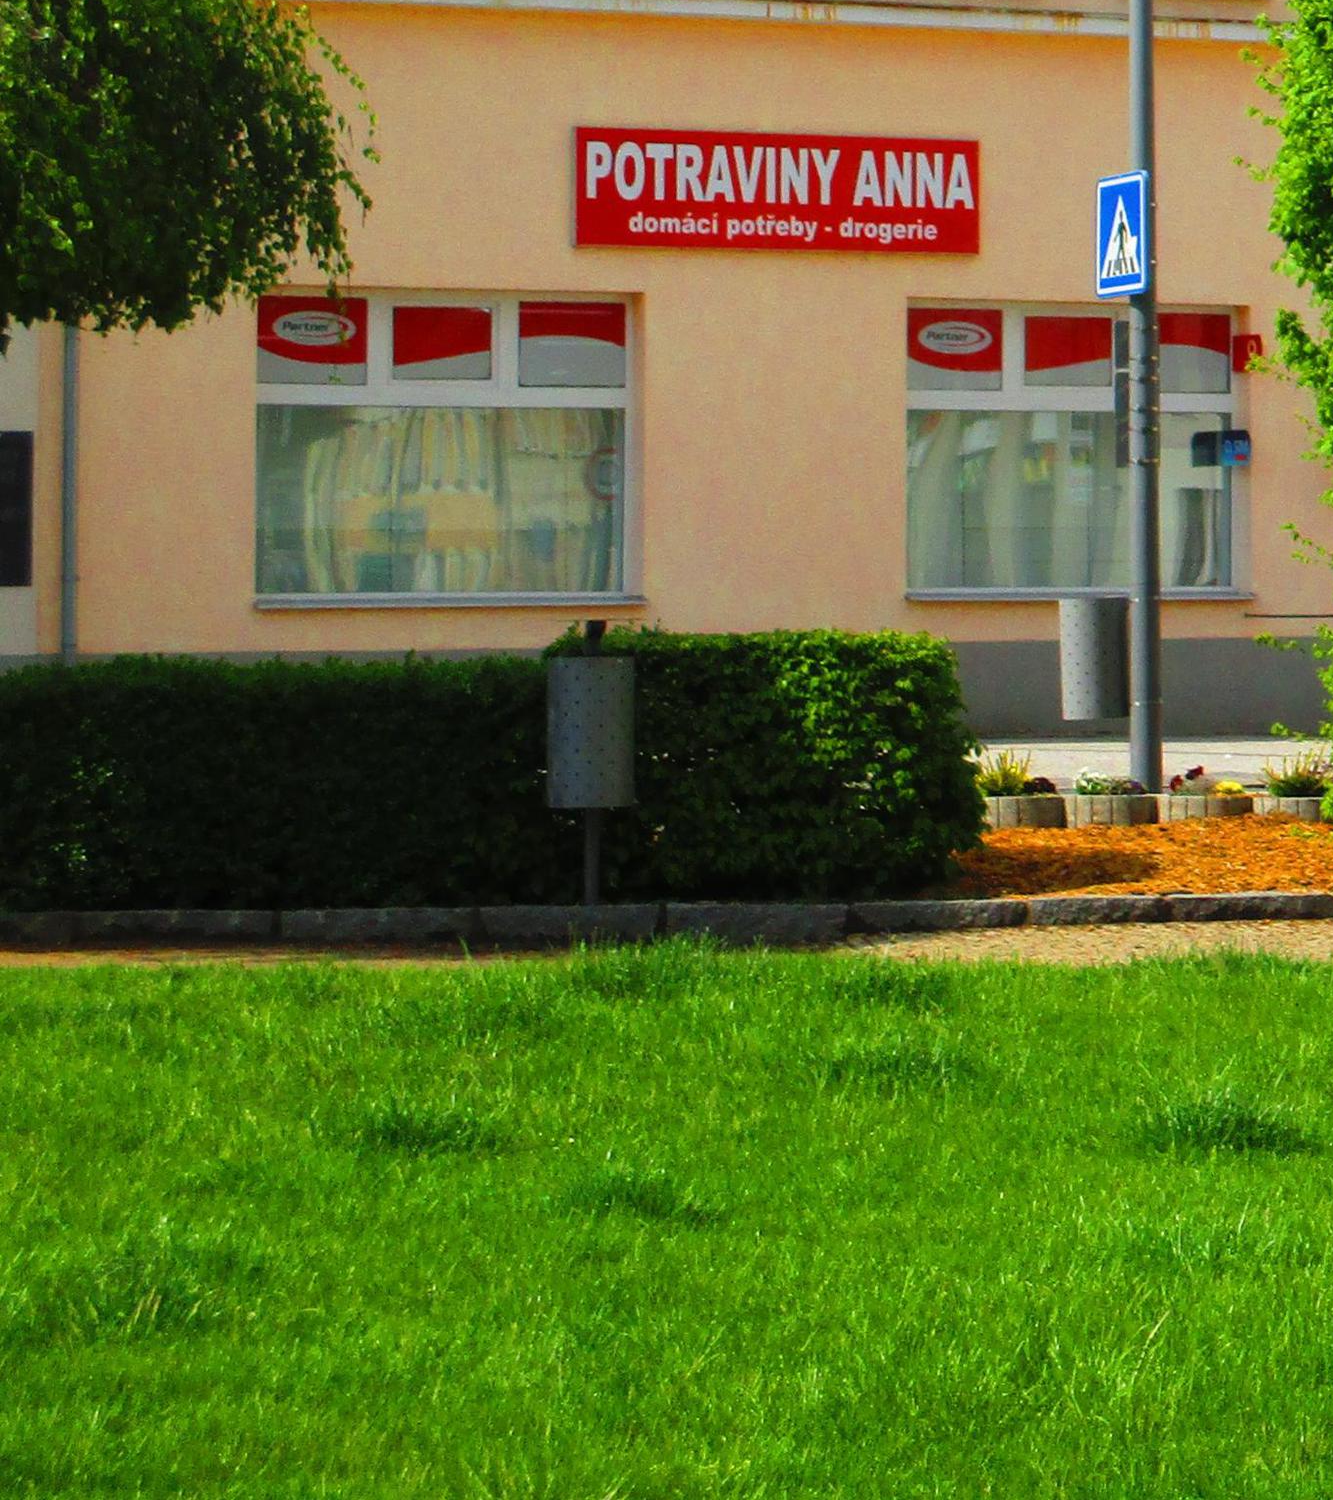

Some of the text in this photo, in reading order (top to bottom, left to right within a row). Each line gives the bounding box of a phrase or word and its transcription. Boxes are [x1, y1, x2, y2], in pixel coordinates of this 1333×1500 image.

[585, 140, 975, 211] POTRAVINY ANNA
[628, 211, 719, 235] domácí
[726, 213, 819, 242] potřeby
[838, 216, 939, 243] drogerie
